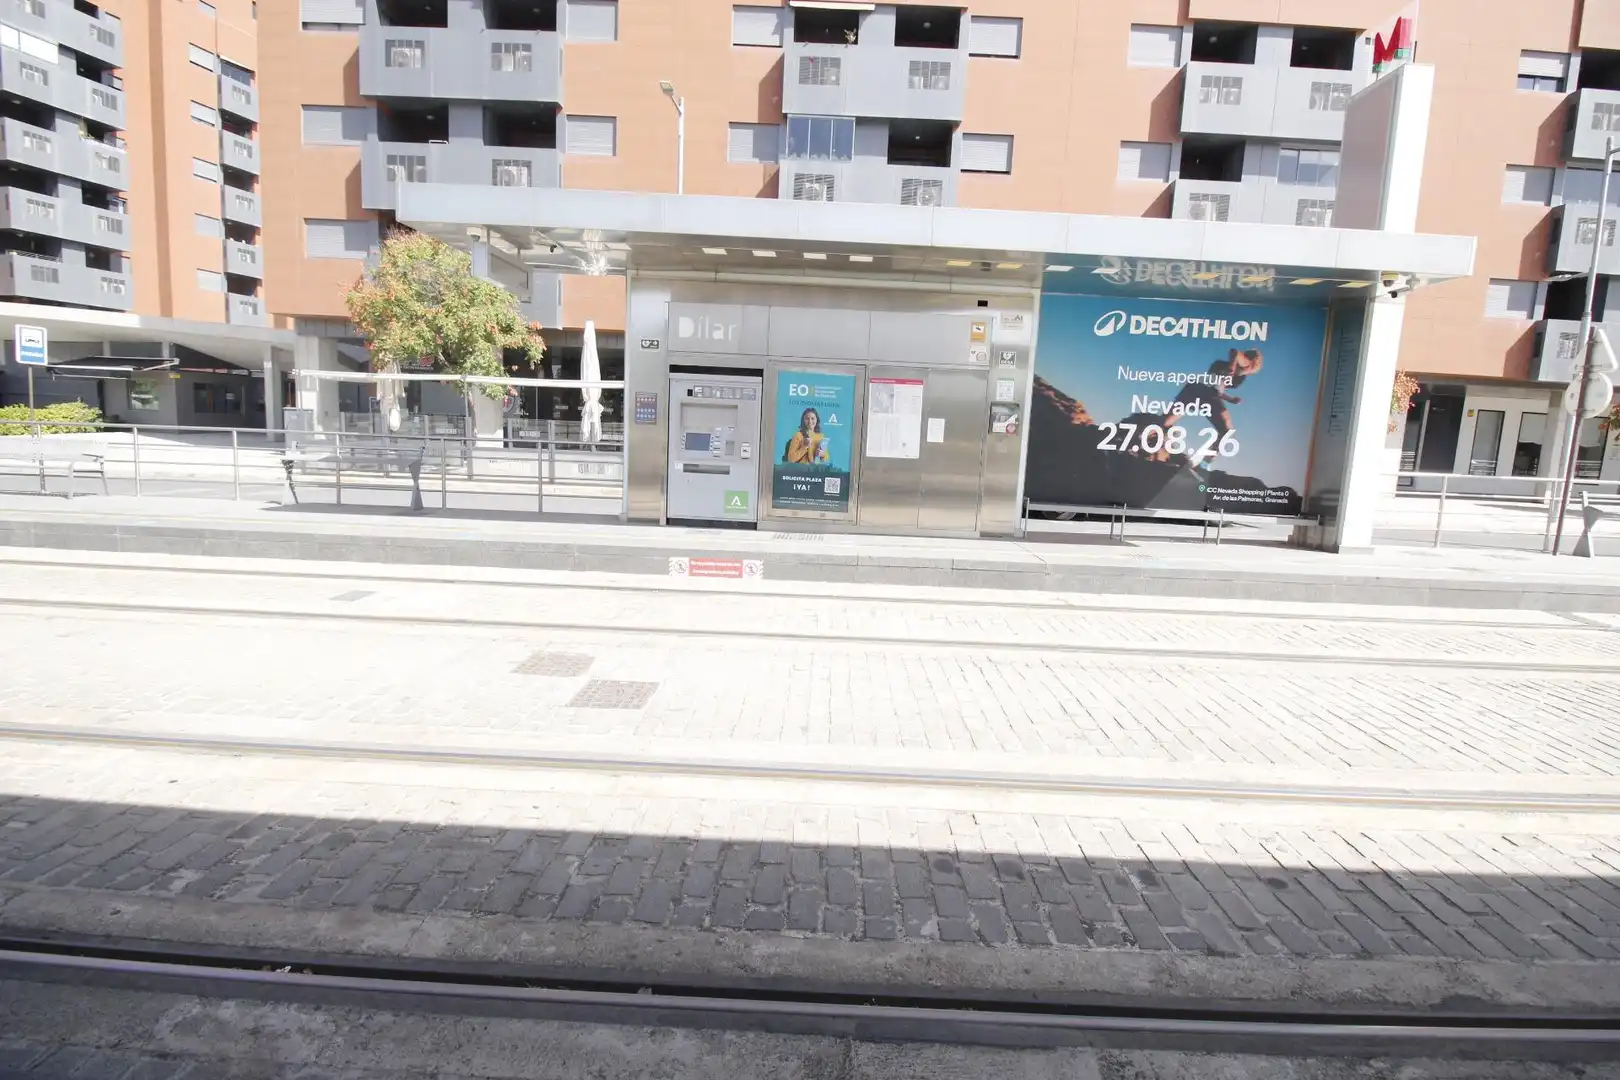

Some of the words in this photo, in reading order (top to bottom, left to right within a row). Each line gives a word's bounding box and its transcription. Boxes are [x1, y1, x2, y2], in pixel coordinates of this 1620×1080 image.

[678, 315, 737, 342] Dílar
[1129, 314, 1269, 342] DECATHLON
[1117, 365, 1165, 383] Nueva
[1167, 371, 1234, 387] apertura
[1131, 394, 1213, 418] Nevada
[1096, 422, 1240, 458] 27.08.26
